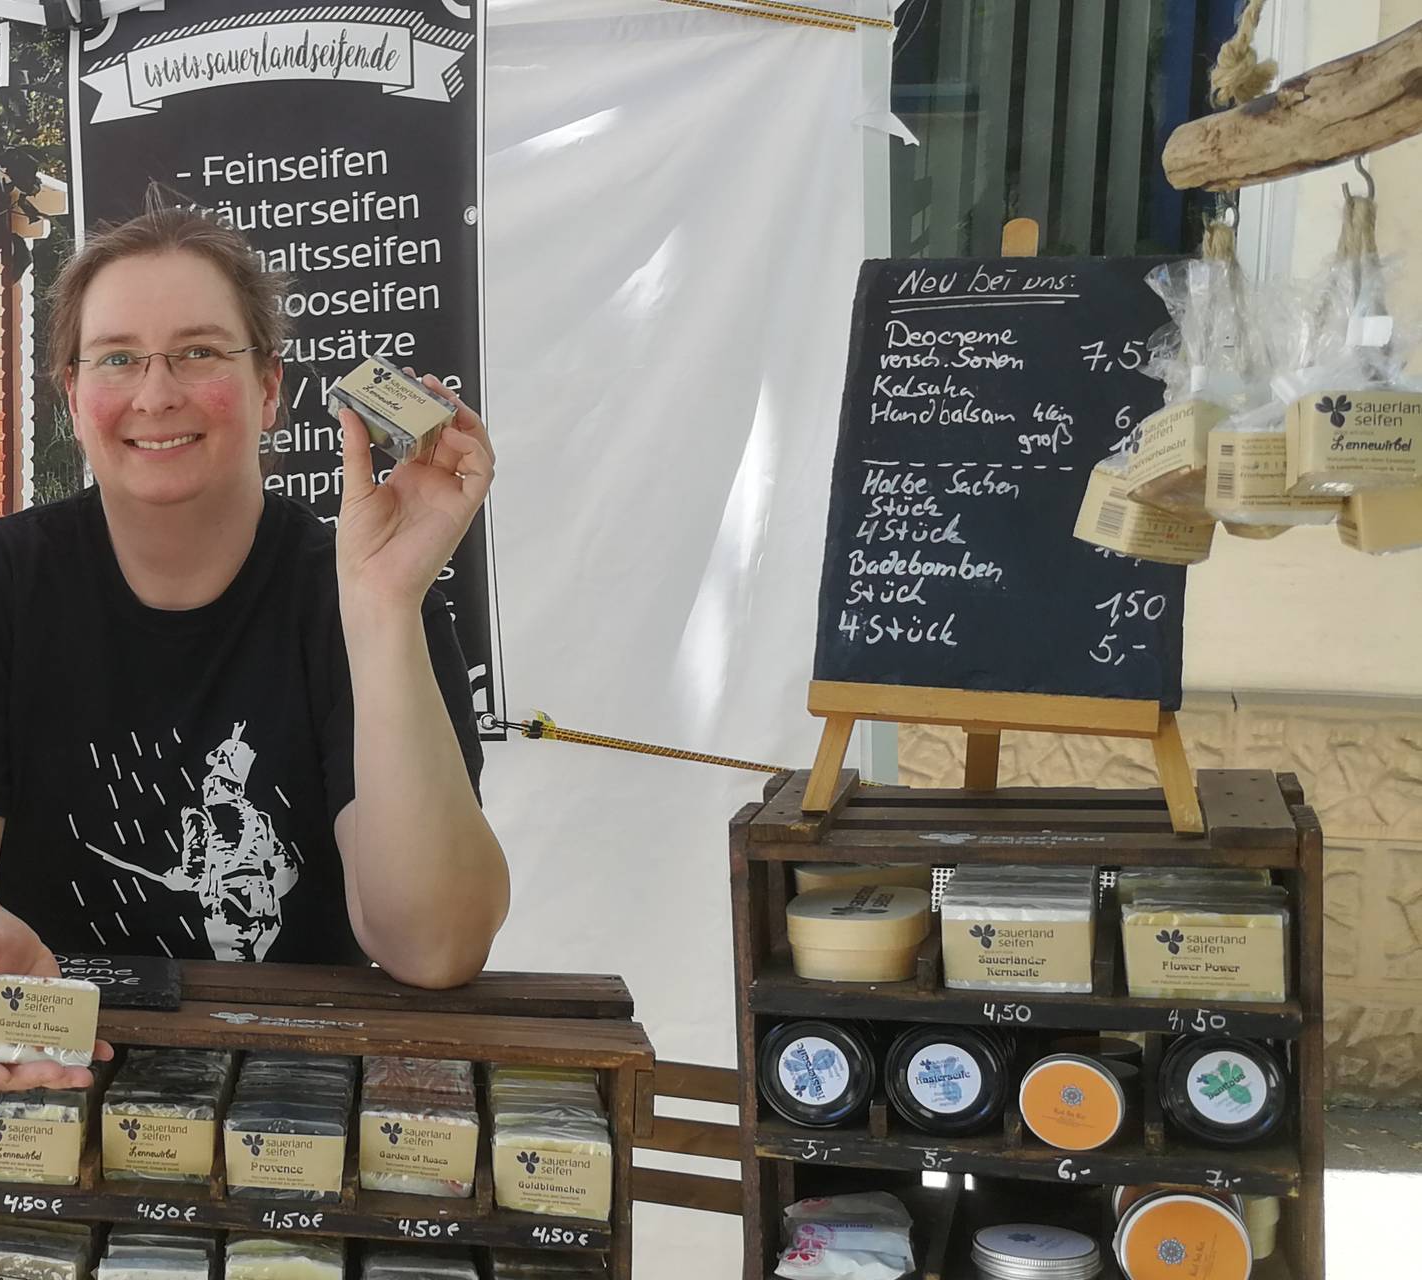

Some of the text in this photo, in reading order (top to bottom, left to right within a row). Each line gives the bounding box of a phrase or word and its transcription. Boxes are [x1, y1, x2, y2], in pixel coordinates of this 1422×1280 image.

[144, 29, 400, 88] www.sauerlandseifen.de
[203, 148, 388, 187] Feinseifen
[176, 191, 420, 231] räuterseifen
[248, 236, 442, 274] haltsseifen
[966, 264, 1012, 293] bei
[1022, 272, 1077, 291] uns:
[276, 282, 440, 318] ooseifen
[885, 320, 1018, 350] Deocreme
[950, 347, 1025, 371] Sorten
[1080, 339, 1152, 373] 7,5
[870, 400, 1016, 425] Handbalsam
[1355, 401, 1422, 415] sauerlan
[1354, 415, 1403, 427] seifen
[1331, 435, 1412, 452] Lennewirbel
[865, 496, 944, 518] Stück
[848, 549, 1003, 583] Badebomben
[845, 579, 927, 606] Stück
[1094, 590, 1167, 625] 1,50
[997, 928, 1054, 939] sauerland
[1186, 933, 1247, 945] sauerland
[998, 938, 1034, 948] seifen
[1186, 943, 1225, 954] seifen
[1162, 961, 1241, 974] Flower Power
[25, 991, 74, 1006] sauerland
[24, 1002, 56, 1013] seifen
[982, 1003, 1033, 1023] 4,50
[0, 1018, 31, 1029] Garden
[32, 1020, 42, 1030] of
[8, 1125, 54, 1135] sauerland
[142, 1123, 188, 1135] sauerland
[405, 1127, 452, 1140] sauerland
[8, 1133, 37, 1143] seifen
[142, 1132, 171, 1142] seifen
[403, 1137, 434, 1147] seifen
[265, 1138, 313, 1150] sauerland
[265, 1148, 296, 1158] seifen
[379, 1151, 410, 1162] Garden
[412, 1153, 421, 1162] of
[250, 1161, 304, 1176] Provence
[541, 1156, 591, 1169] sauerland
[540, 1166, 572, 1176] seifen
[518, 1180, 587, 1195] Goldblümchen
